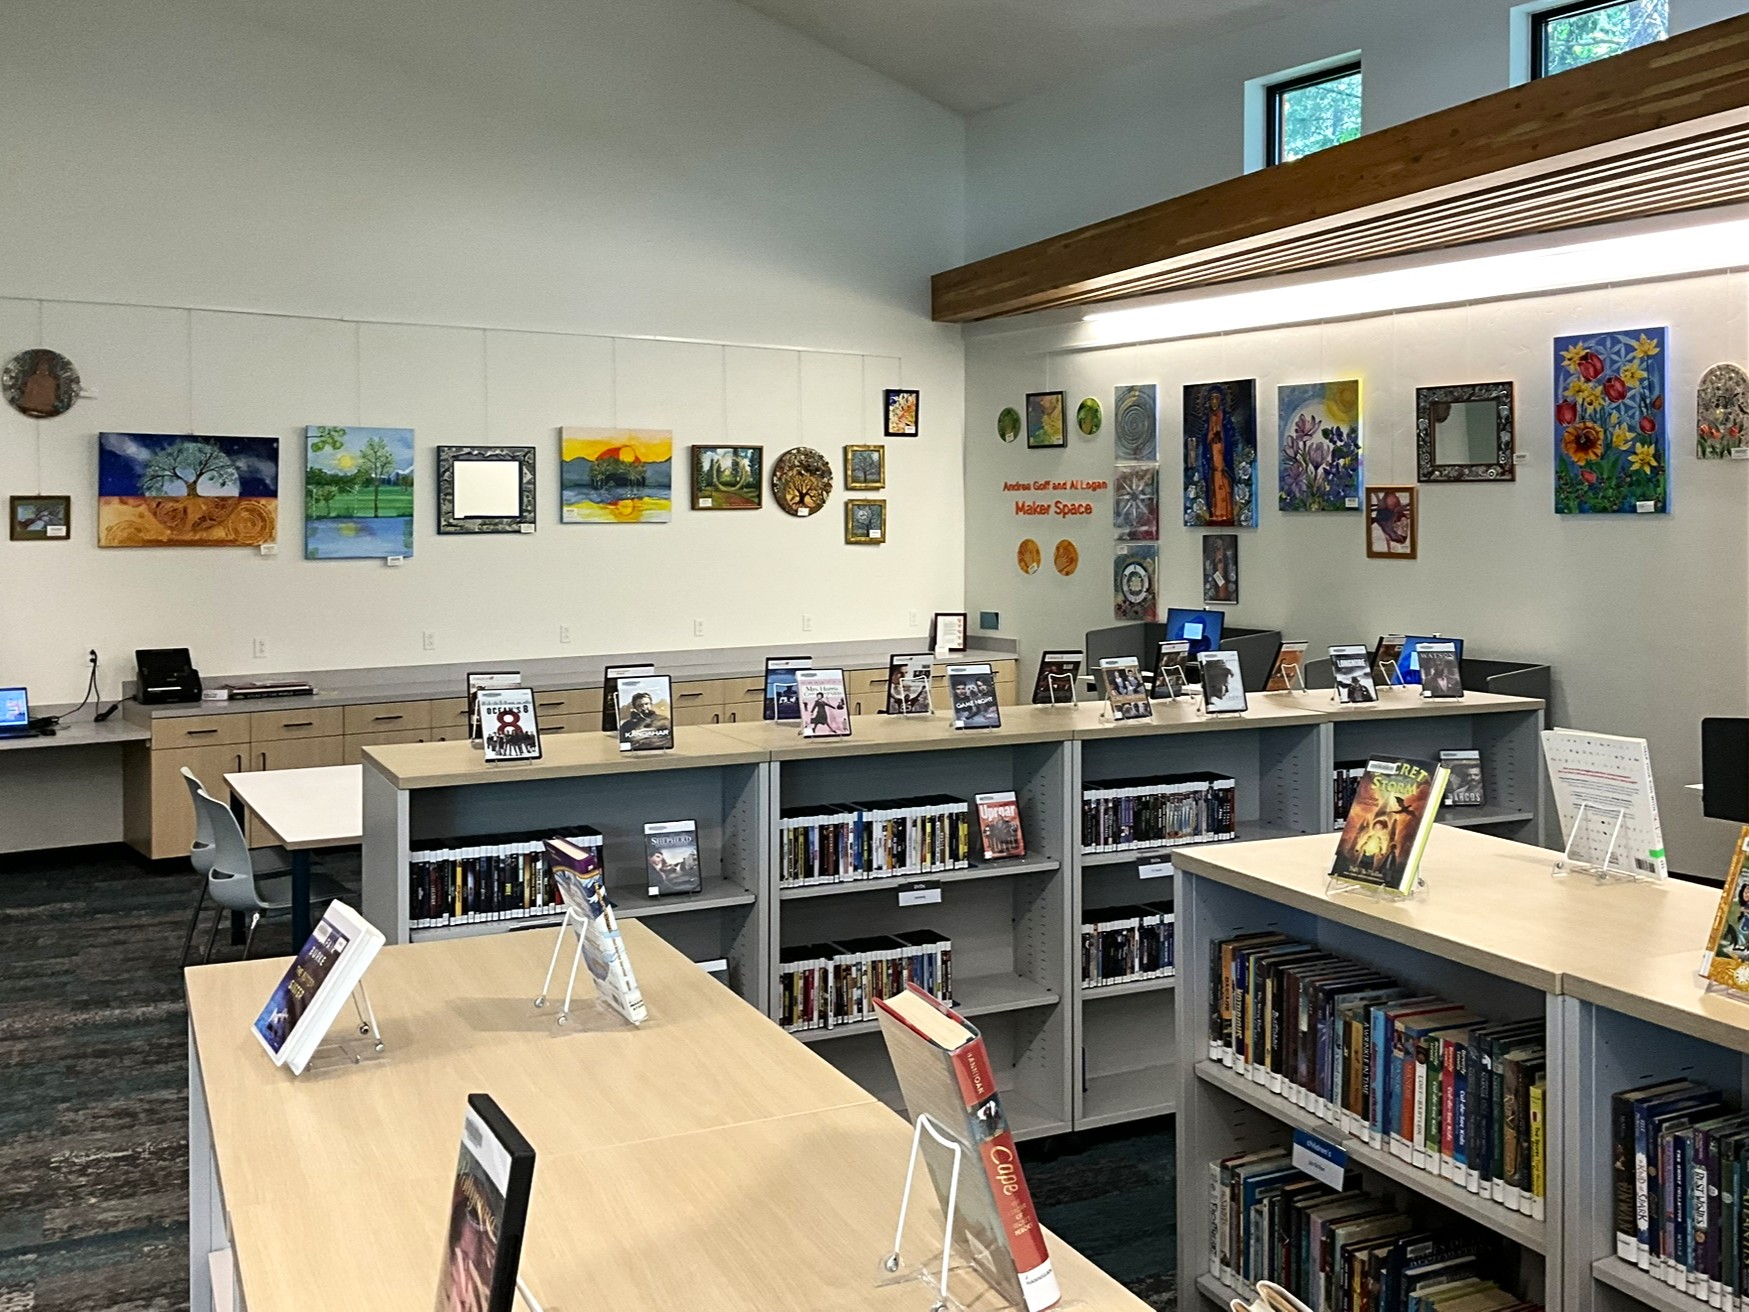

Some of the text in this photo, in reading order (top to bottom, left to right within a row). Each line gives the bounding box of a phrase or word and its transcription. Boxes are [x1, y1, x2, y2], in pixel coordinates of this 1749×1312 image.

[1003, 481, 1031, 492] Andrea
[1033, 480, 1050, 491] Goff
[1052, 481, 1067, 490] and
[1080, 480, 1107, 492] Logan
[1015, 500, 1093, 518] Maker Space
[1420, 652, 1454, 660] WATSON
[522, 704, 529, 714] 8
[956, 699, 975, 709] GAME
[979, 803, 1015, 819] Uproar
[308, 945, 328, 967] BURKE
[967, 1052, 984, 1095] HANNIGAN
[1362, 1065, 1370, 1074] IN
[1361, 1076, 1369, 1096] TIME
[990, 1146, 1019, 1196] Cape
[1636, 1164, 1648, 1184] KIND
[1636, 1194, 1649, 1222] SPARK
